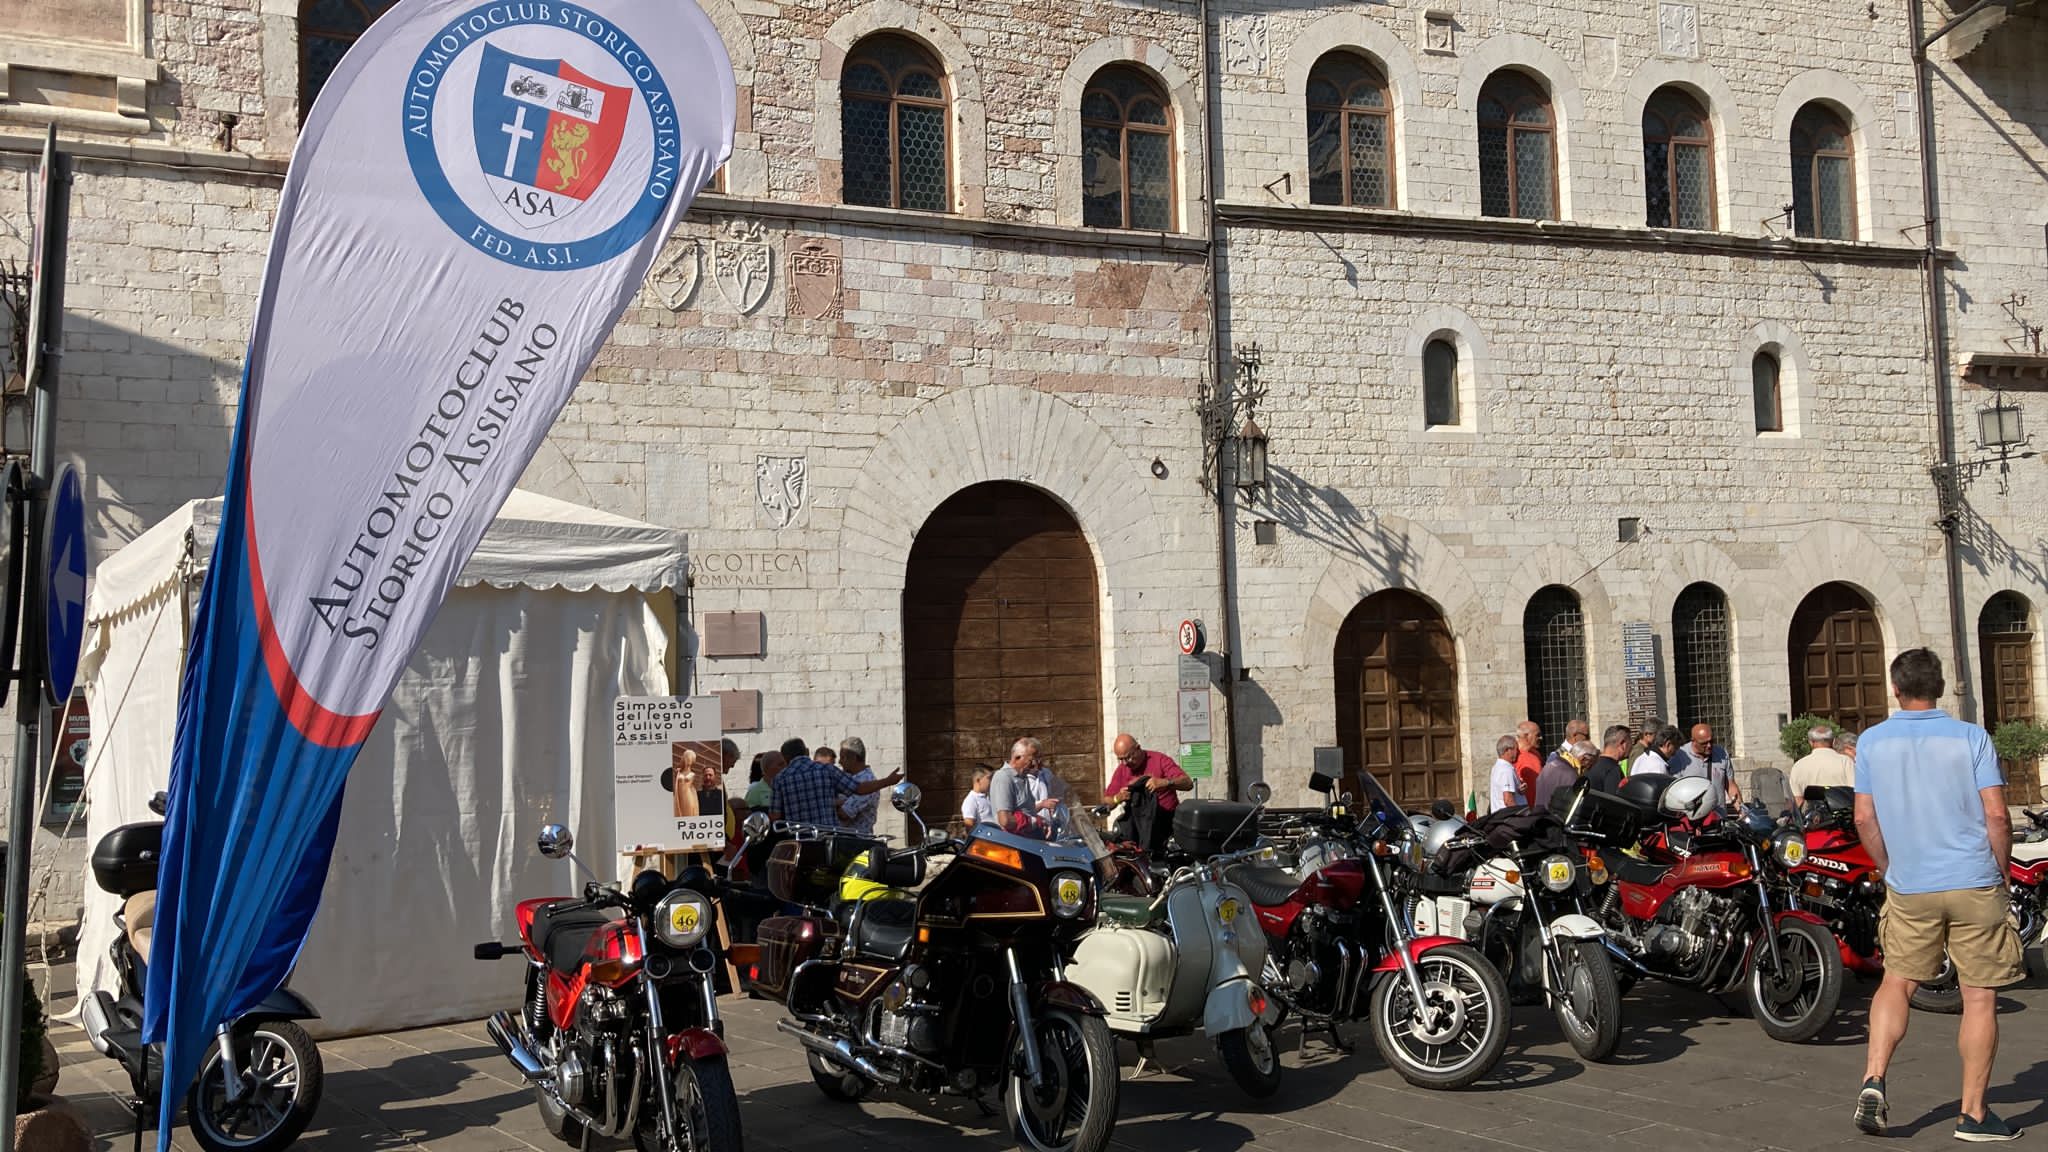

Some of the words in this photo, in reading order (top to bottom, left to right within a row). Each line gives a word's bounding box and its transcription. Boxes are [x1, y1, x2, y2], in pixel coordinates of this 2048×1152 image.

[409, 3, 551, 138] AUTOMOTOCLUB
[558, 8, 653, 83] STORICO
[645, 89, 676, 200] ASSISANO
[503, 186, 558, 218] ASA
[470, 224, 516, 260] FED.
[524, 247, 580, 265] A.S.I.
[308, 297, 526, 636] AUTOMOTOCLUB
[691, 553, 803, 573] ACOTECA
[342, 492, 454, 650] STORICO
[694, 574, 774, 586] OMVNALE
[616, 701, 693, 714] Simposio
[616, 712, 641, 721] del
[647, 712, 692, 722] legno
[679, 720, 693, 729] di
[616, 731, 668, 741] Assisi
[677, 819, 724, 831] Paolo
[681, 831, 724, 841] Moro
[1808, 856, 1849, 872] ONDA
[675, 914, 694, 927] 46
